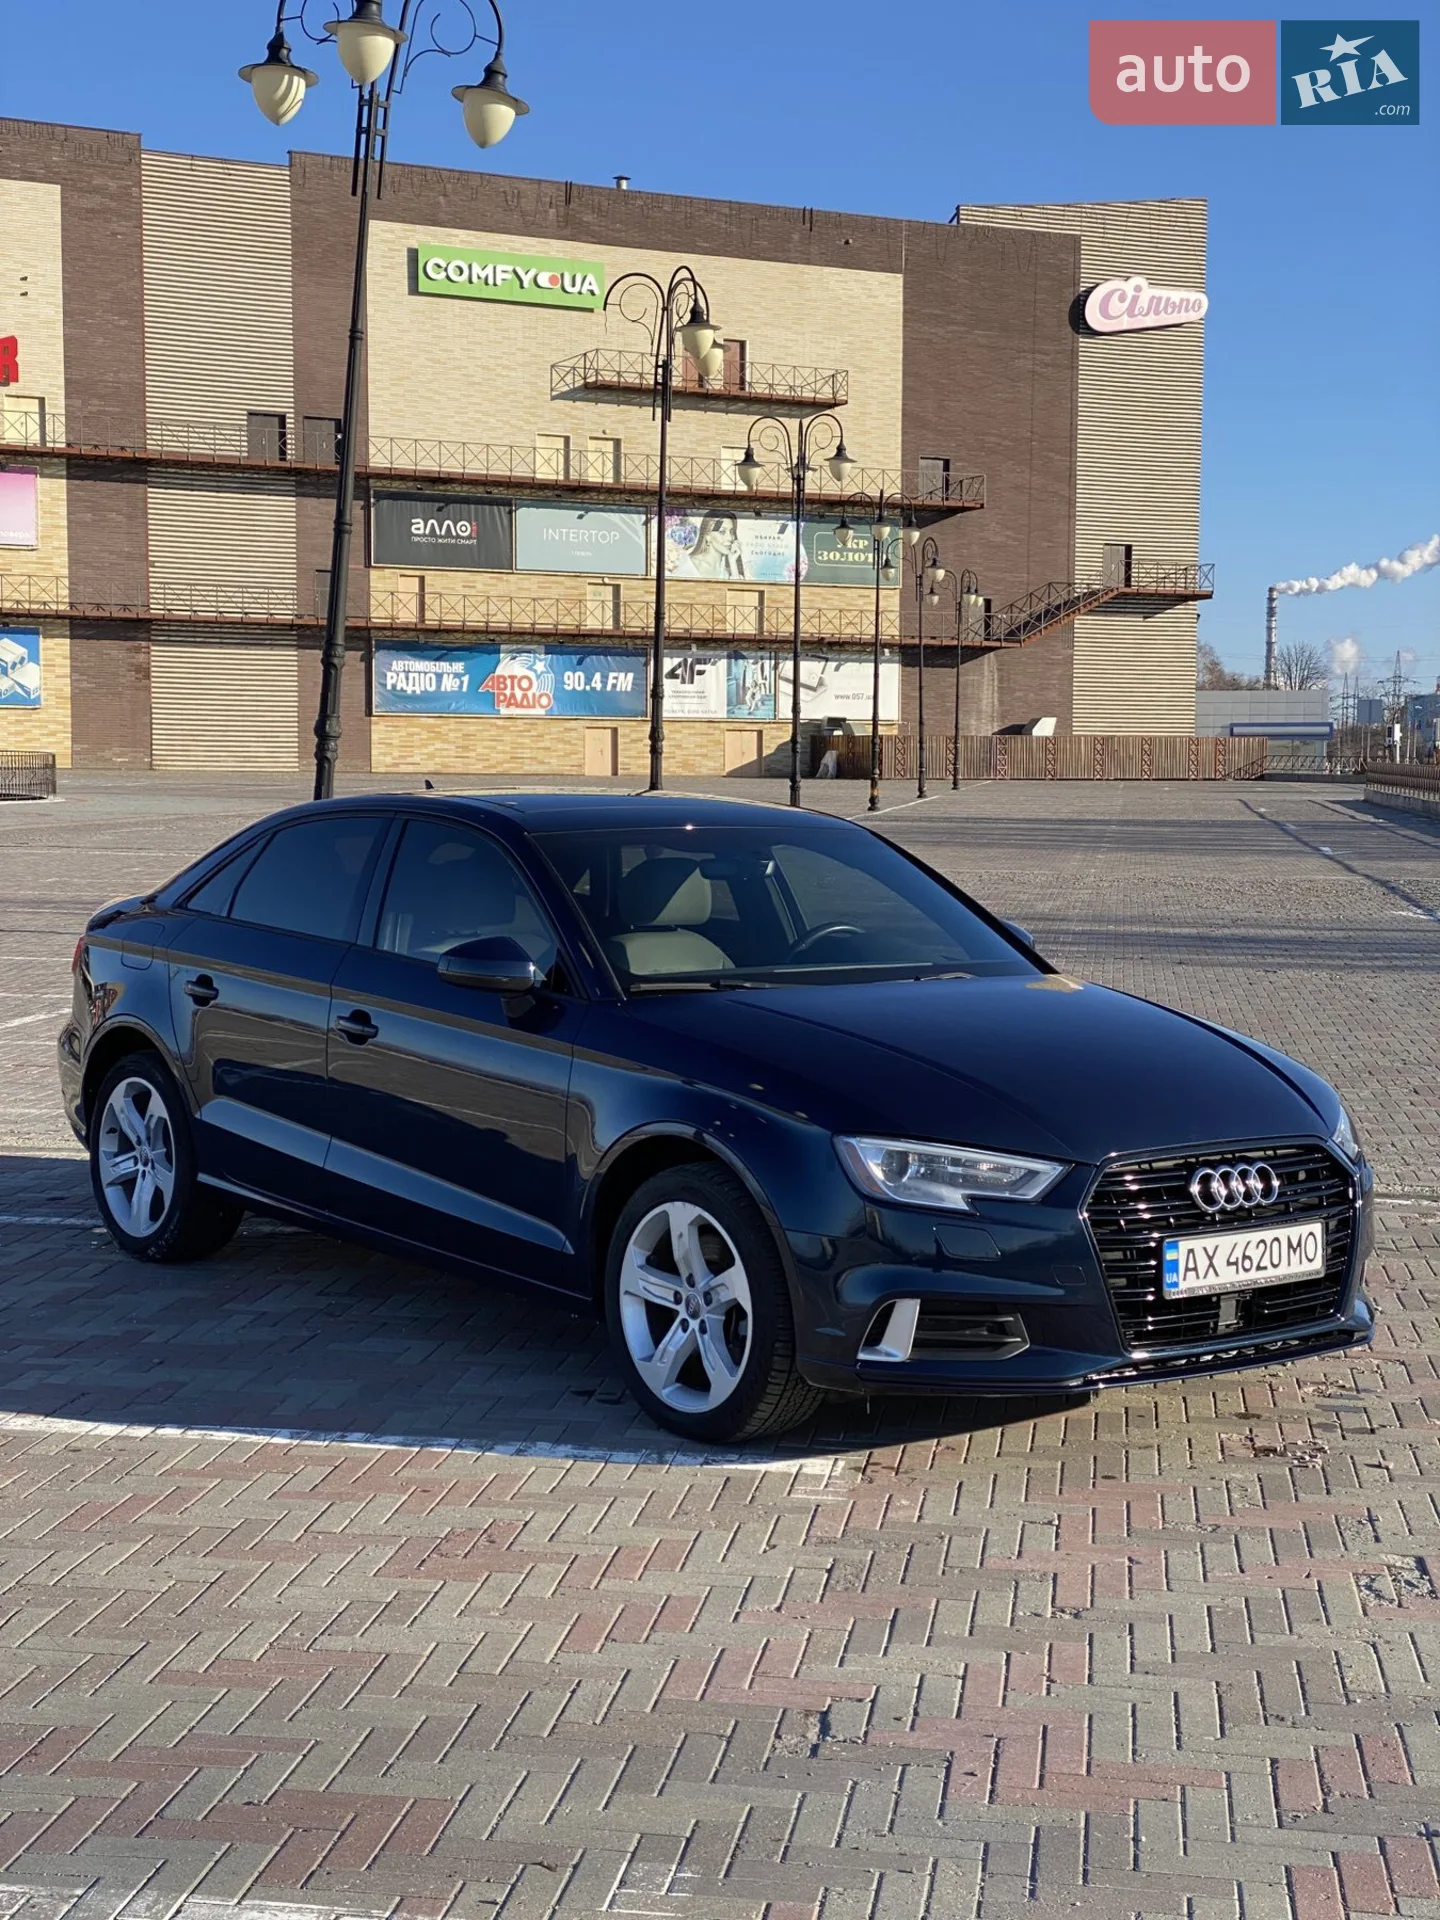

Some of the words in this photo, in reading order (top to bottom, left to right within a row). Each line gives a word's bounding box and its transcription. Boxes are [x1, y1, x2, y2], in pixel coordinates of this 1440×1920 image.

[1098, 283, 1204, 321] Сільпо
[543, 527, 620, 544] INTERTOP
[391, 660, 465, 673] АВТОМОБІЛЬНЕ
[386, 671, 436, 695] РАДІО
[441, 673, 470, 693] №1
[478, 673, 535, 693] АВТО
[563, 671, 602, 692] 90.4
[606, 671, 634, 692] FM
[495, 691, 554, 710] РАДІО
[1183, 1243, 1220, 1281] AX
[1226, 1236, 1282, 1273] 4620
[1287, 1230, 1318, 1267] MO
[1165, 1272, 1178, 1284] UA
